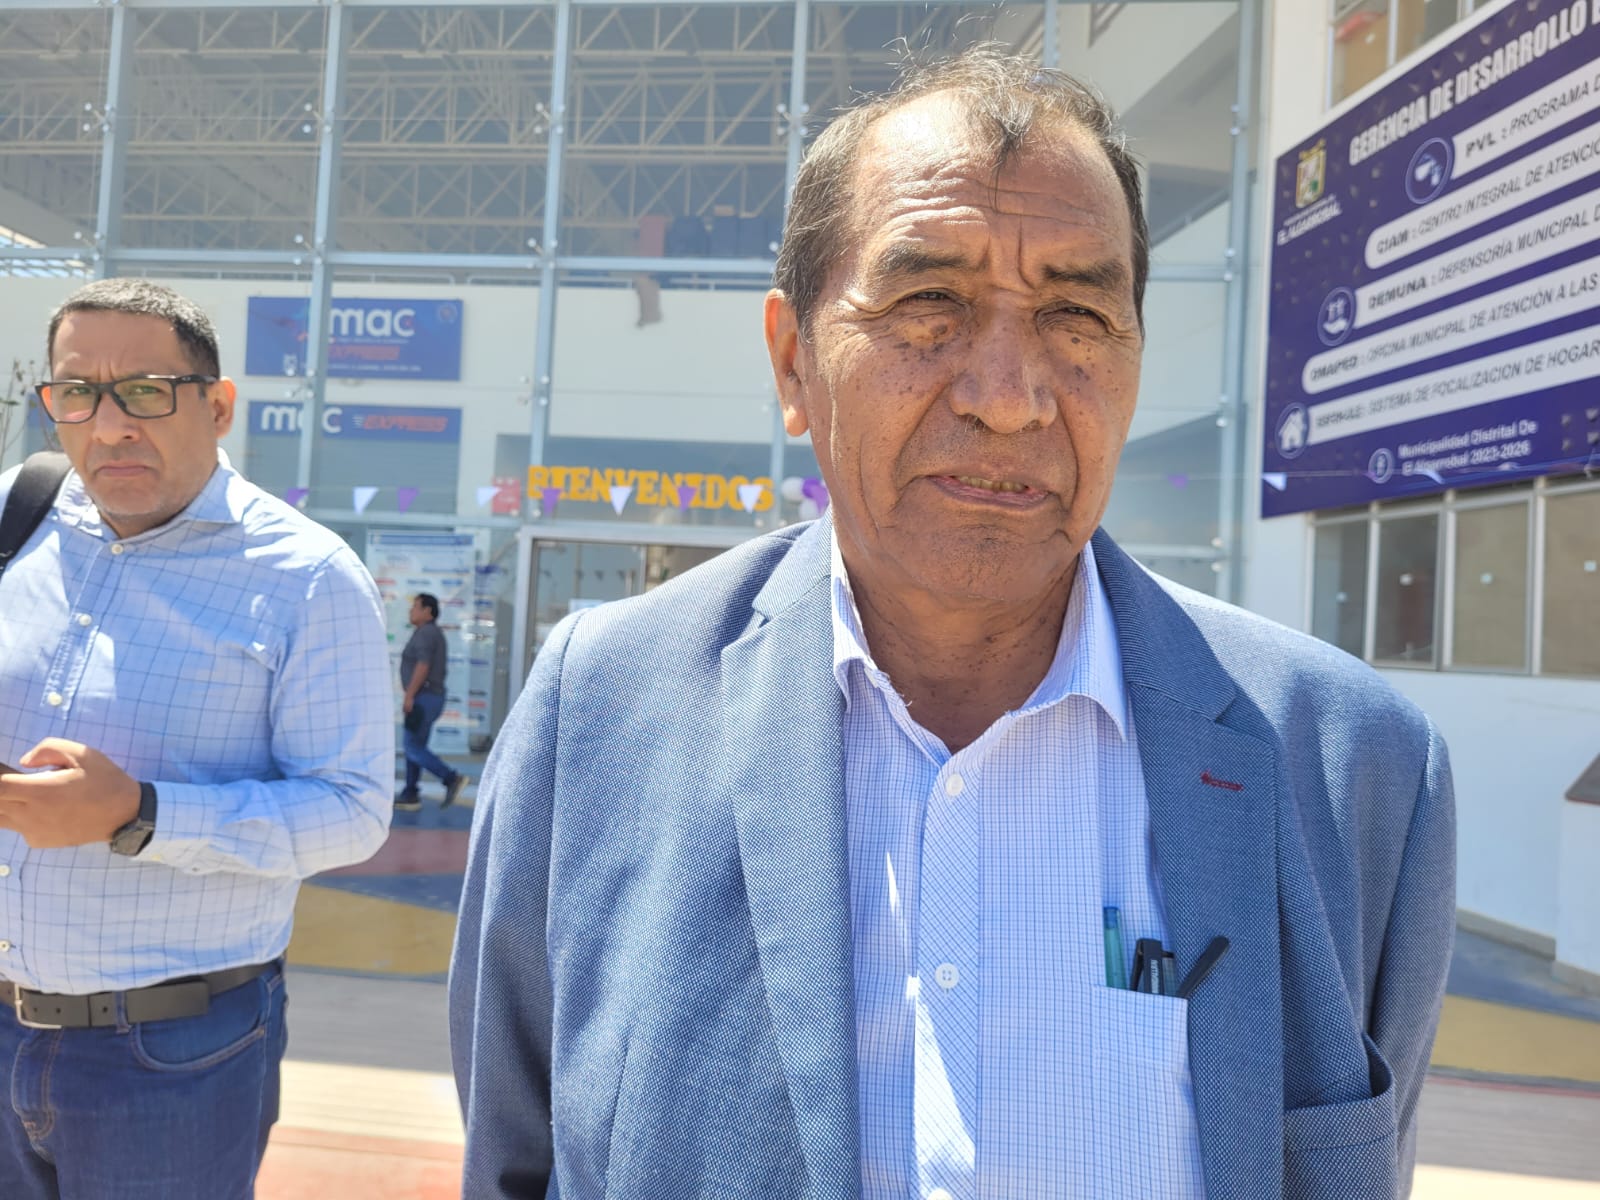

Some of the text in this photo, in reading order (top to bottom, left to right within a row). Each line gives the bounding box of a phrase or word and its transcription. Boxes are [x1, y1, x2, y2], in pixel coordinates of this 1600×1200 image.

[1349, 95, 1427, 166] GERENCIA
[1429, 79, 1453, 120] DE
[1455, 0, 1586, 104] DESARROLLO
[1510, 80, 1589, 135] PROGRAMA
[1419, 204, 1462, 234] CENTRO
[1463, 176, 1521, 214] INTEGRAL
[1525, 165, 1543, 187] DE
[1368, 276, 1427, 309] DEMUNA
[1516, 210, 1589, 251] MUNICIPAL
[330, 308, 416, 337] mac
[1408, 319, 1466, 349] MUNICIPAL
[1469, 309, 1487, 330] DE
[1556, 283, 1566, 300] A
[1569, 273, 1598, 297] LAS
[1413, 384, 1431, 402] DE
[1524, 354, 1545, 375] DE
[1398, 419, 1538, 459] Municipalidad Distrital De
